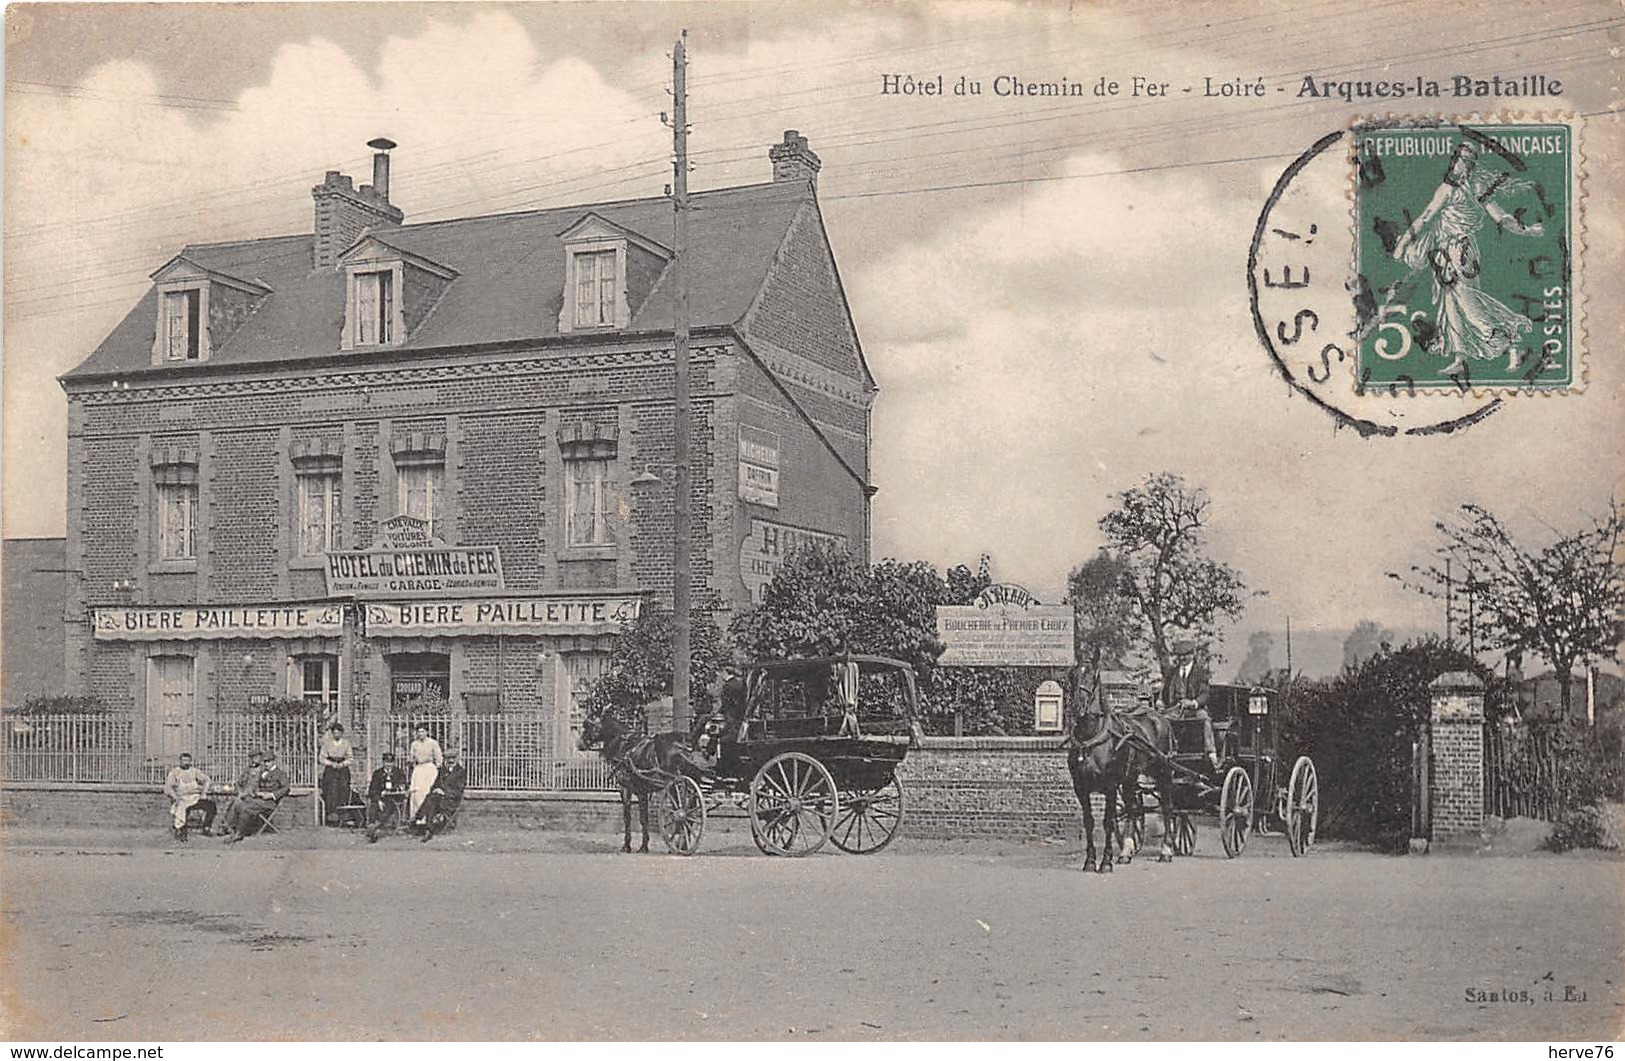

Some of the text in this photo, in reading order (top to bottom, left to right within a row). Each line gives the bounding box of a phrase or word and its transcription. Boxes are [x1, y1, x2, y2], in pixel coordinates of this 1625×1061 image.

[1543, 286, 1562, 369] POSTES
[387, 532, 427, 541] VOITURES
[329, 551, 497, 578] HOTEL du CHEMIN de FER
[389, 579, 441, 591] GARAGE
[125, 608, 309, 630] BIERE PAILLETTE
[399, 602, 607, 624] BIERE PAILLETTE
